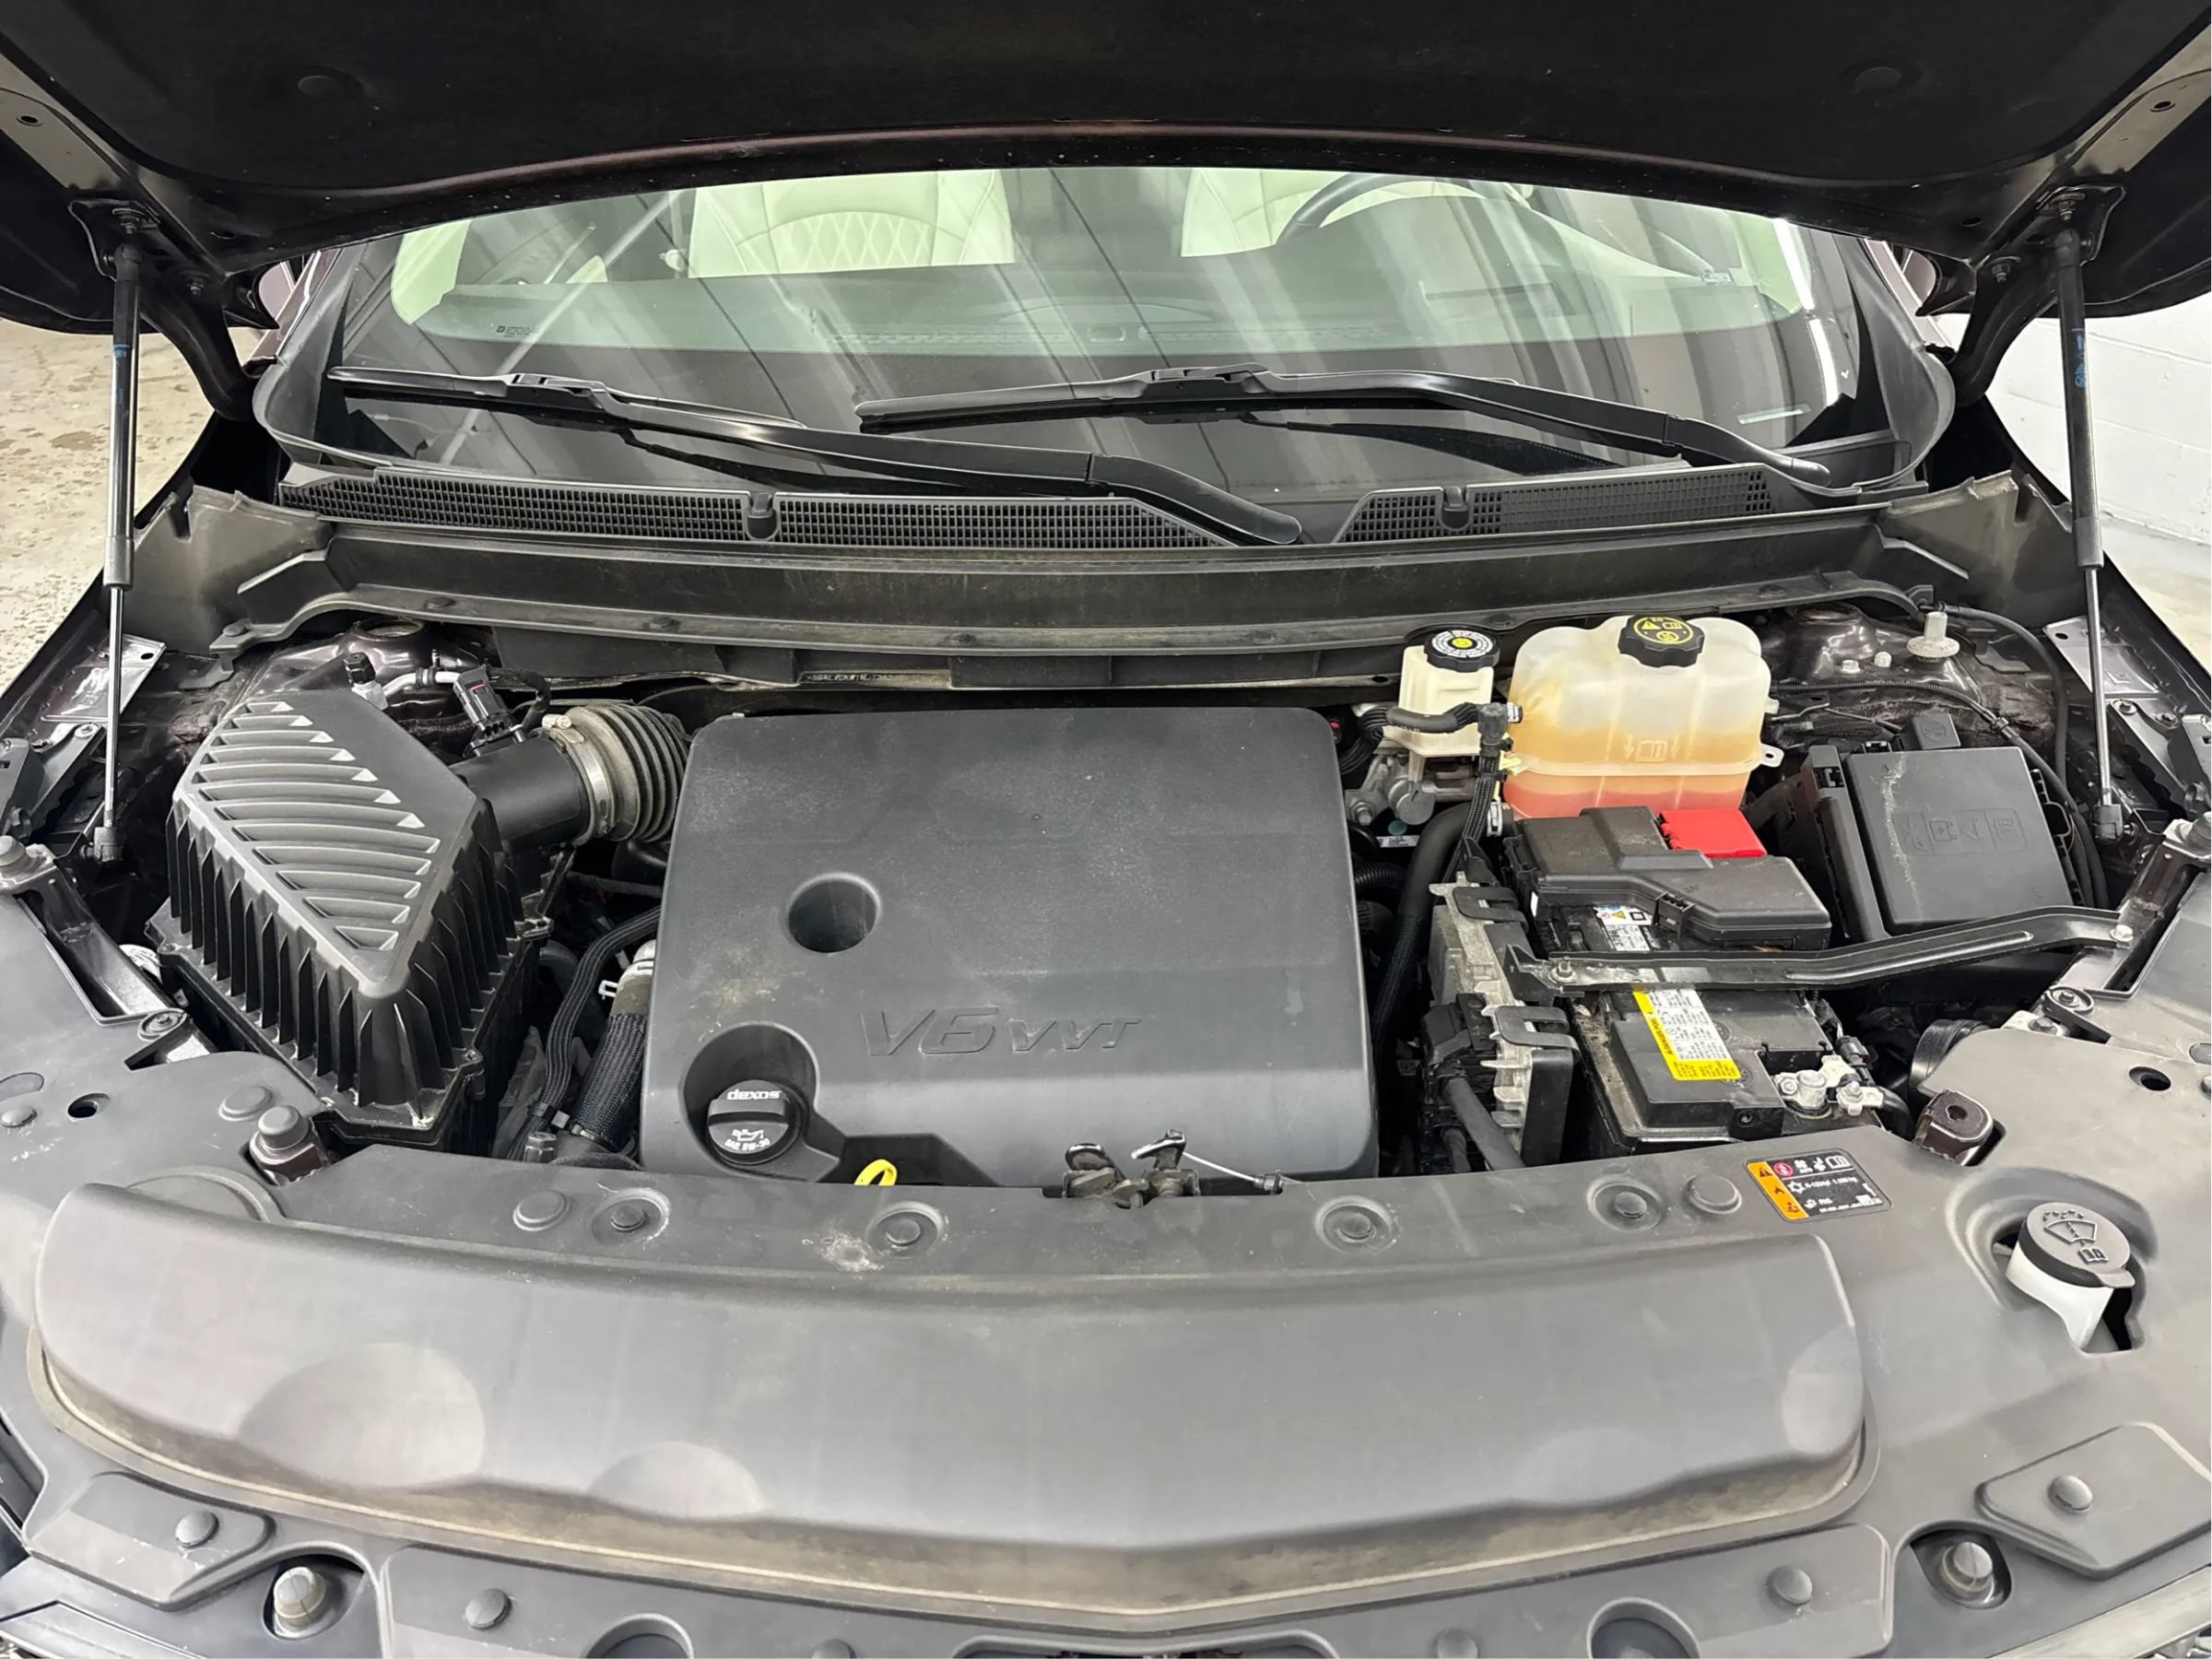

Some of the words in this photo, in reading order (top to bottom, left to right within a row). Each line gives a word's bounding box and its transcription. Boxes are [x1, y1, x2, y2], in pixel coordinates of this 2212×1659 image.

[861, 1006, 999, 1057] V6
[1006, 1017, 1143, 1053] VVT
[726, 1088, 782, 1100] dexos
